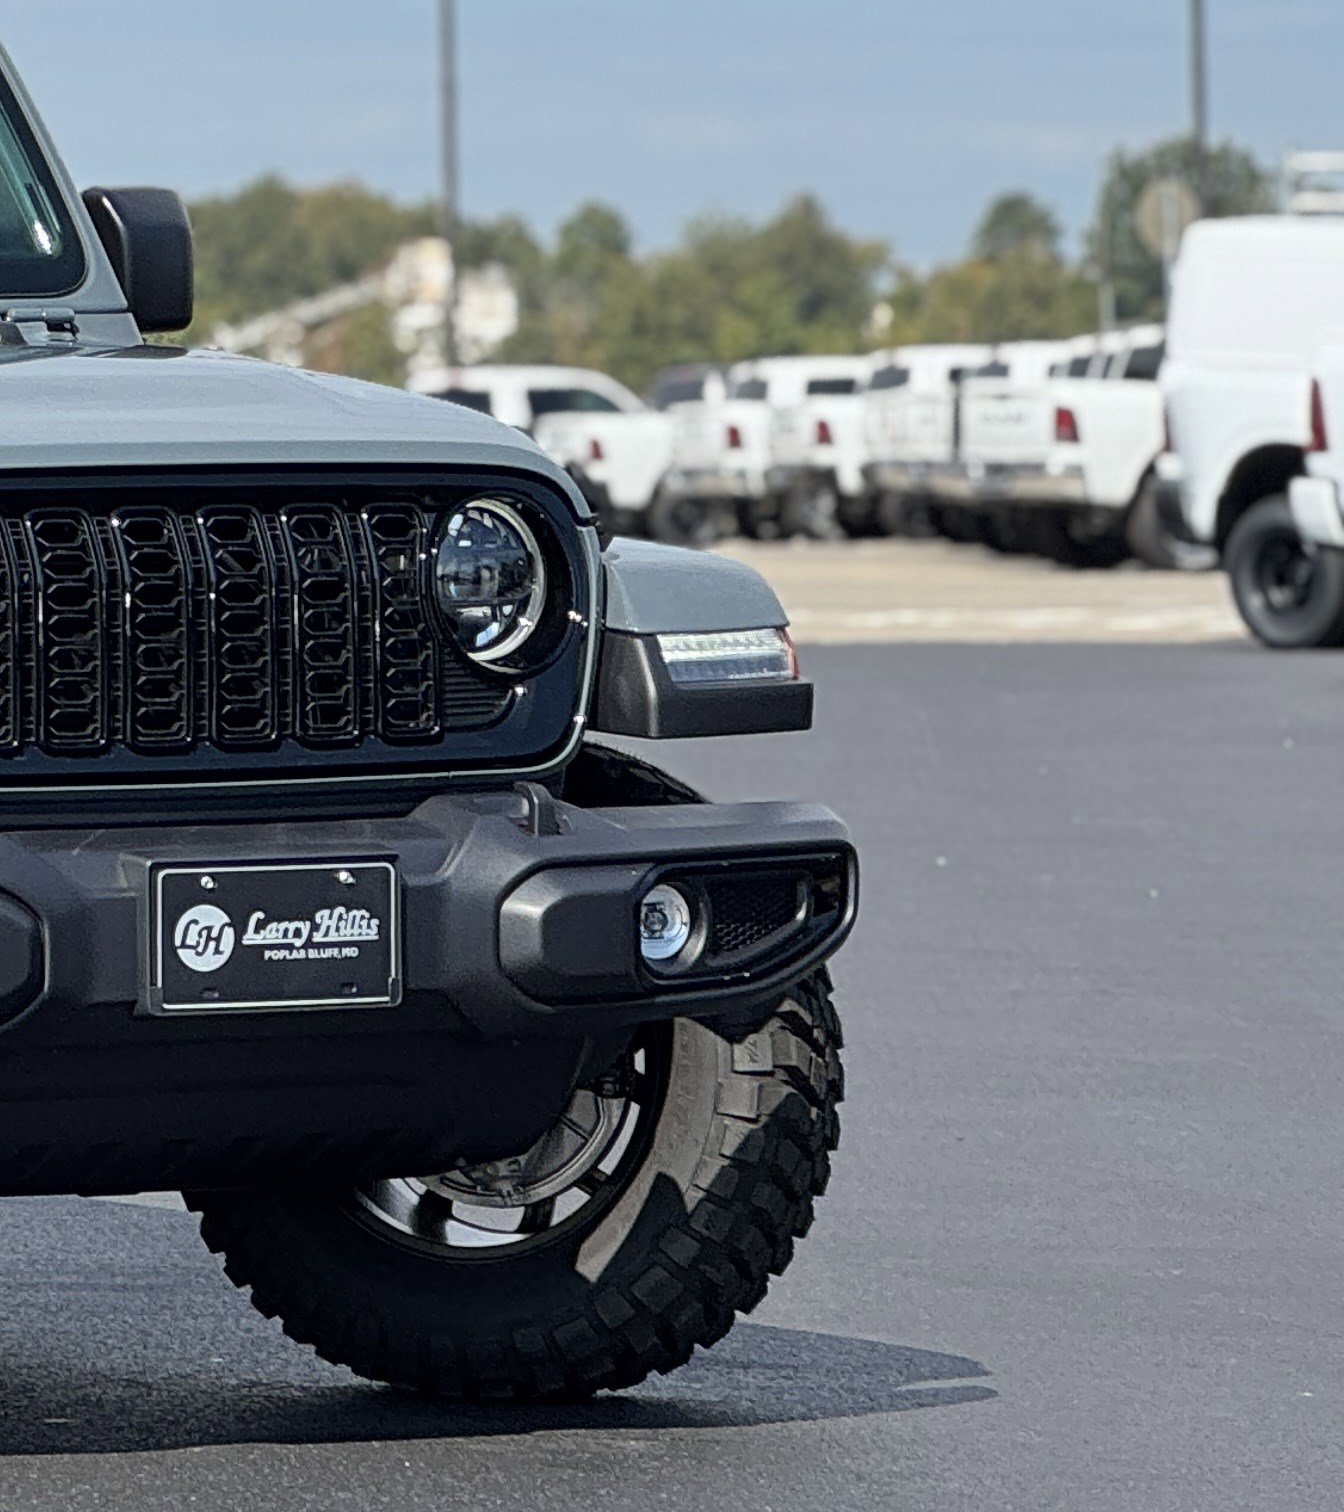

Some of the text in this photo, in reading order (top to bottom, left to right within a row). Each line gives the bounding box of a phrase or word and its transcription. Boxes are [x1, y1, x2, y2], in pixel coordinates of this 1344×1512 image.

[241, 906, 380, 947] Larry Hillis
[264, 948, 307, 961] POPLAR
[342, 946, 359, 959] MO
